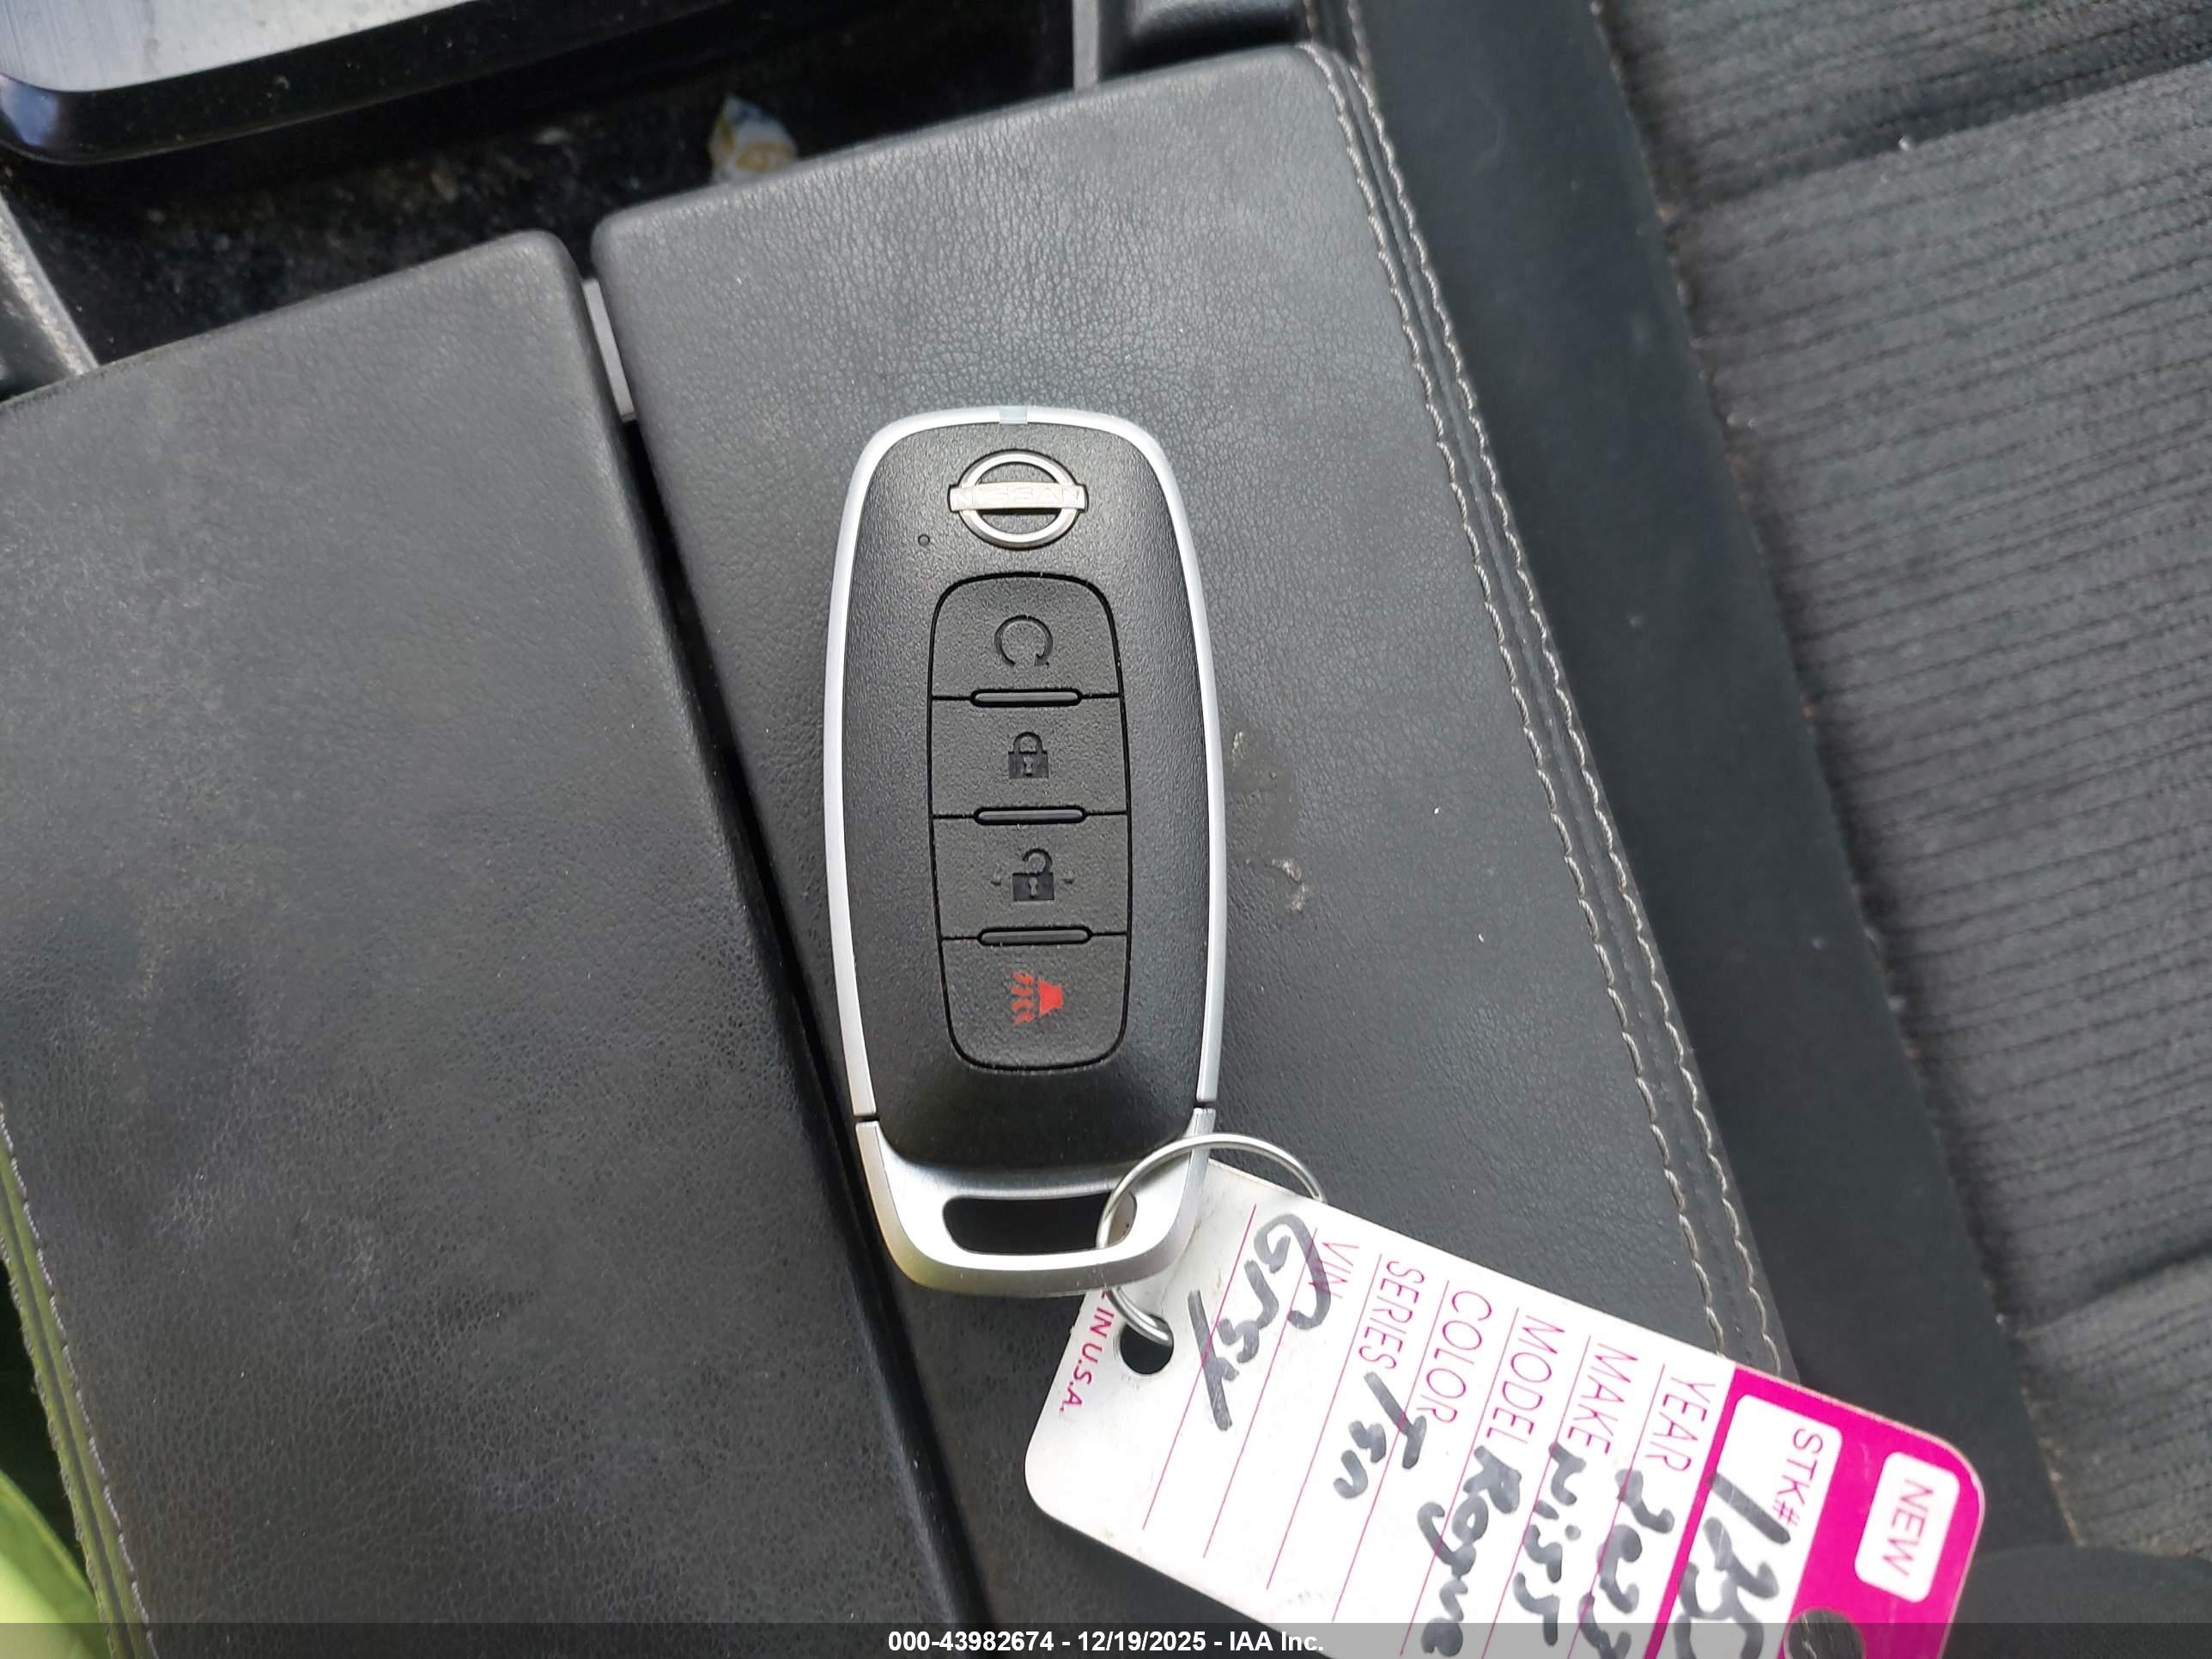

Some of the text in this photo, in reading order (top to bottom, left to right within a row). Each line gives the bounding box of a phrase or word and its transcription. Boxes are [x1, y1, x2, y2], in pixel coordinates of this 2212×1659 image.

[956, 484, 1081, 506] NISSAN
[1308, 1242, 1360, 1299] VIN
[1358, 1260, 1425, 1370] SERIES
[1058, 1306, 1115, 1413] IN U.S.A.
[1416, 1291, 1493, 1424] COLOR
[1486, 1315, 1565, 1444] MODEL
[1567, 1342, 1639, 1455] MAKE
[1644, 1376, 1717, 1473] YEAR
[1771, 1427, 1824, 1527] STK#
[1418, 1445, 1522, 1658] Rogue
[1881, 1478, 1935, 1577] NEW
